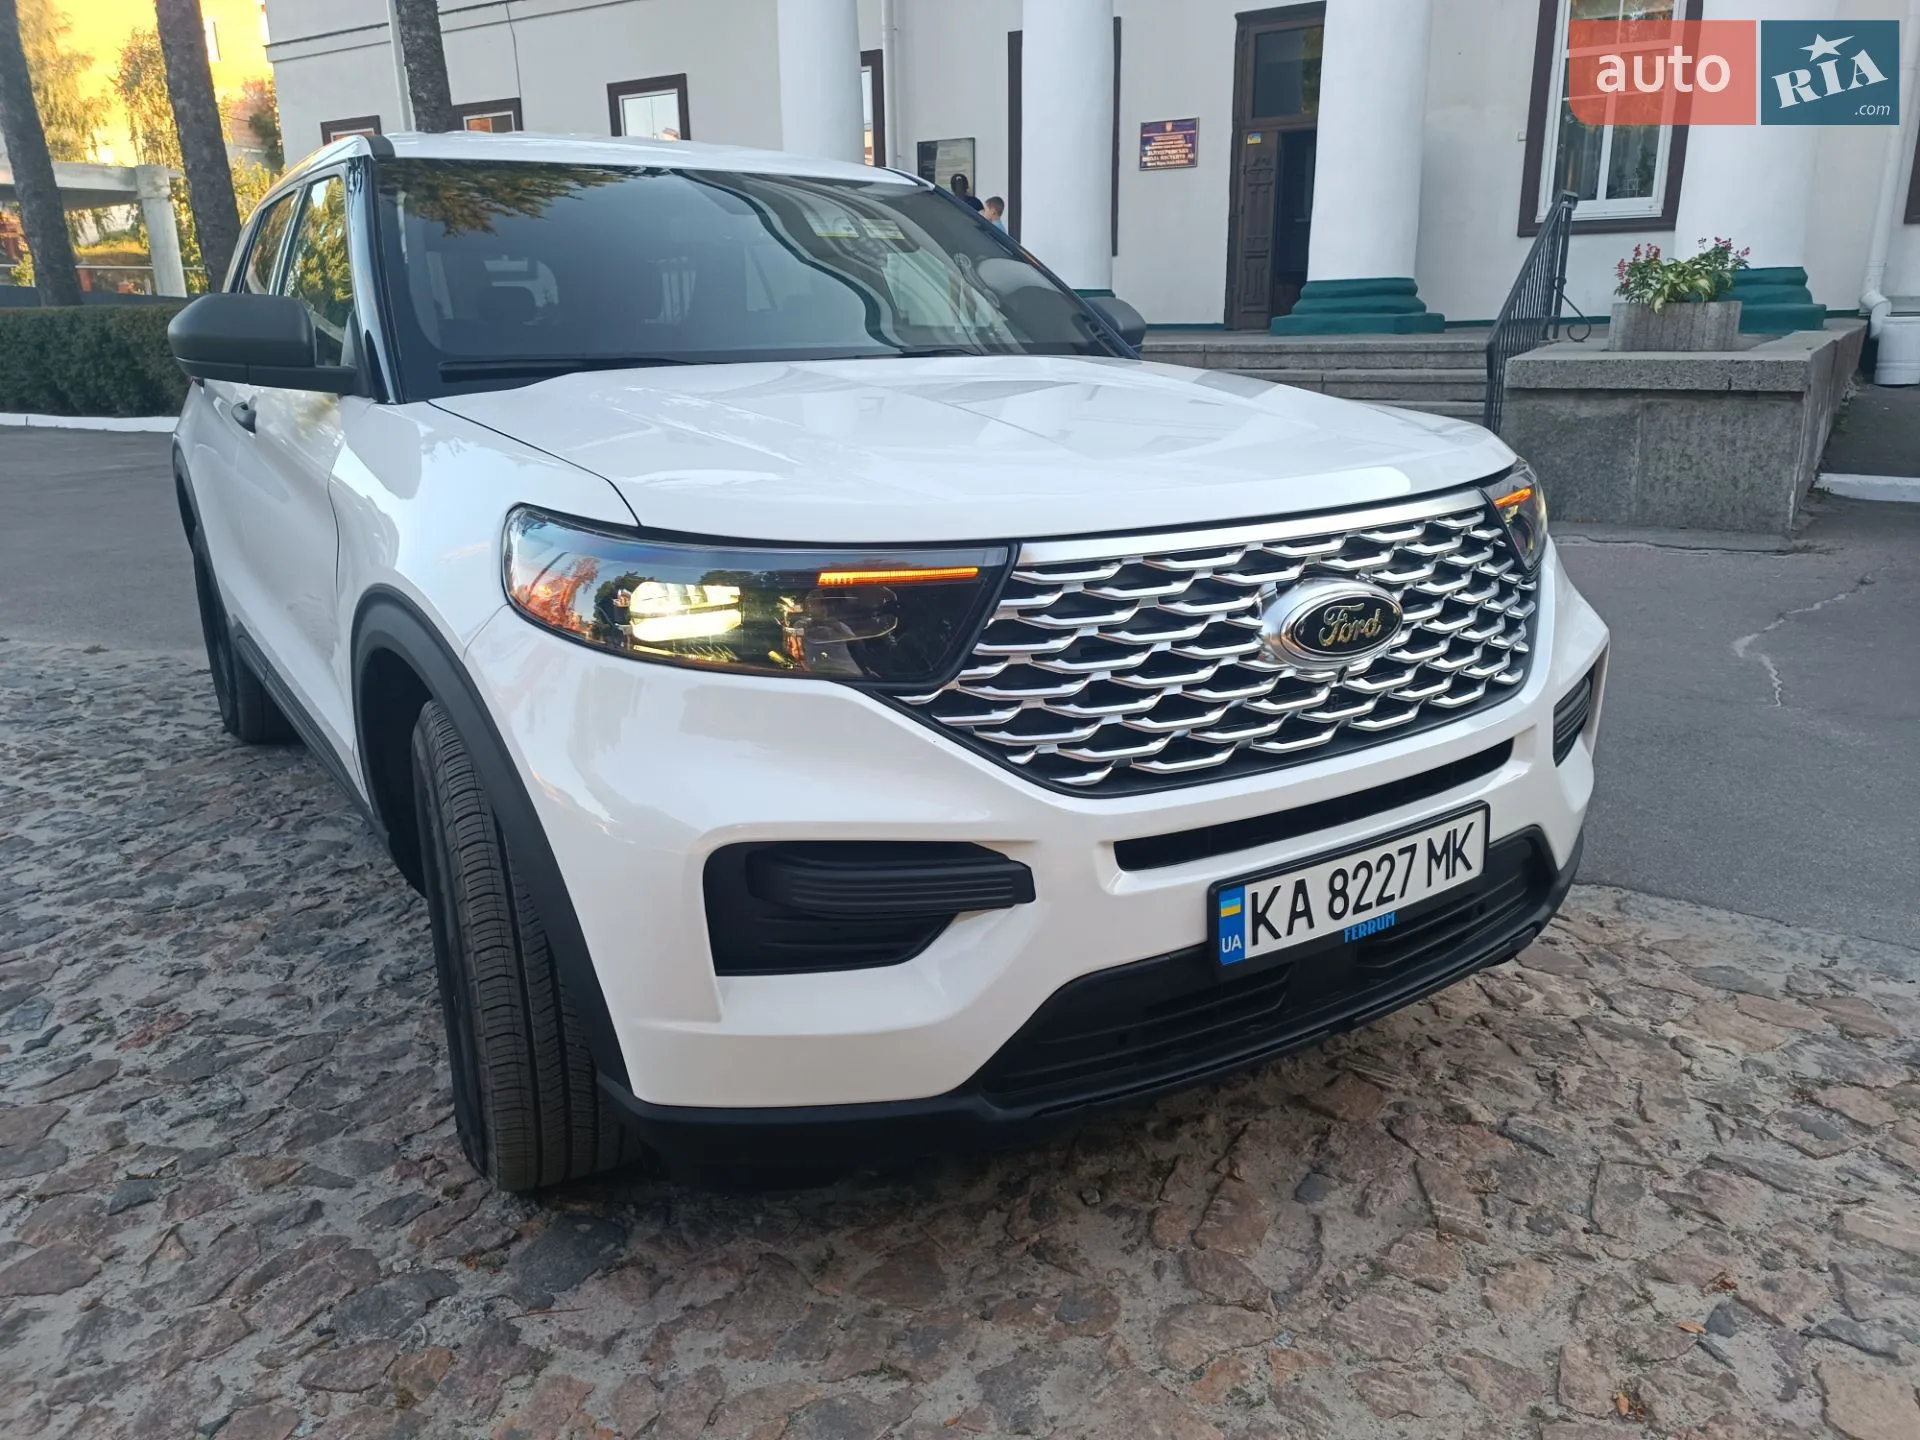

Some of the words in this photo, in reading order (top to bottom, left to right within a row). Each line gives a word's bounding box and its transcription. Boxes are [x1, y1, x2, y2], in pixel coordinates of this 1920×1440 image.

[1318, 602, 1382, 647] Ford
[1250, 878, 1315, 946] KA
[1328, 842, 1418, 921] 8227
[1426, 821, 1475, 888] MK
[1221, 933, 1242, 953] UA
[1343, 911, 1397, 943] FERRUM
